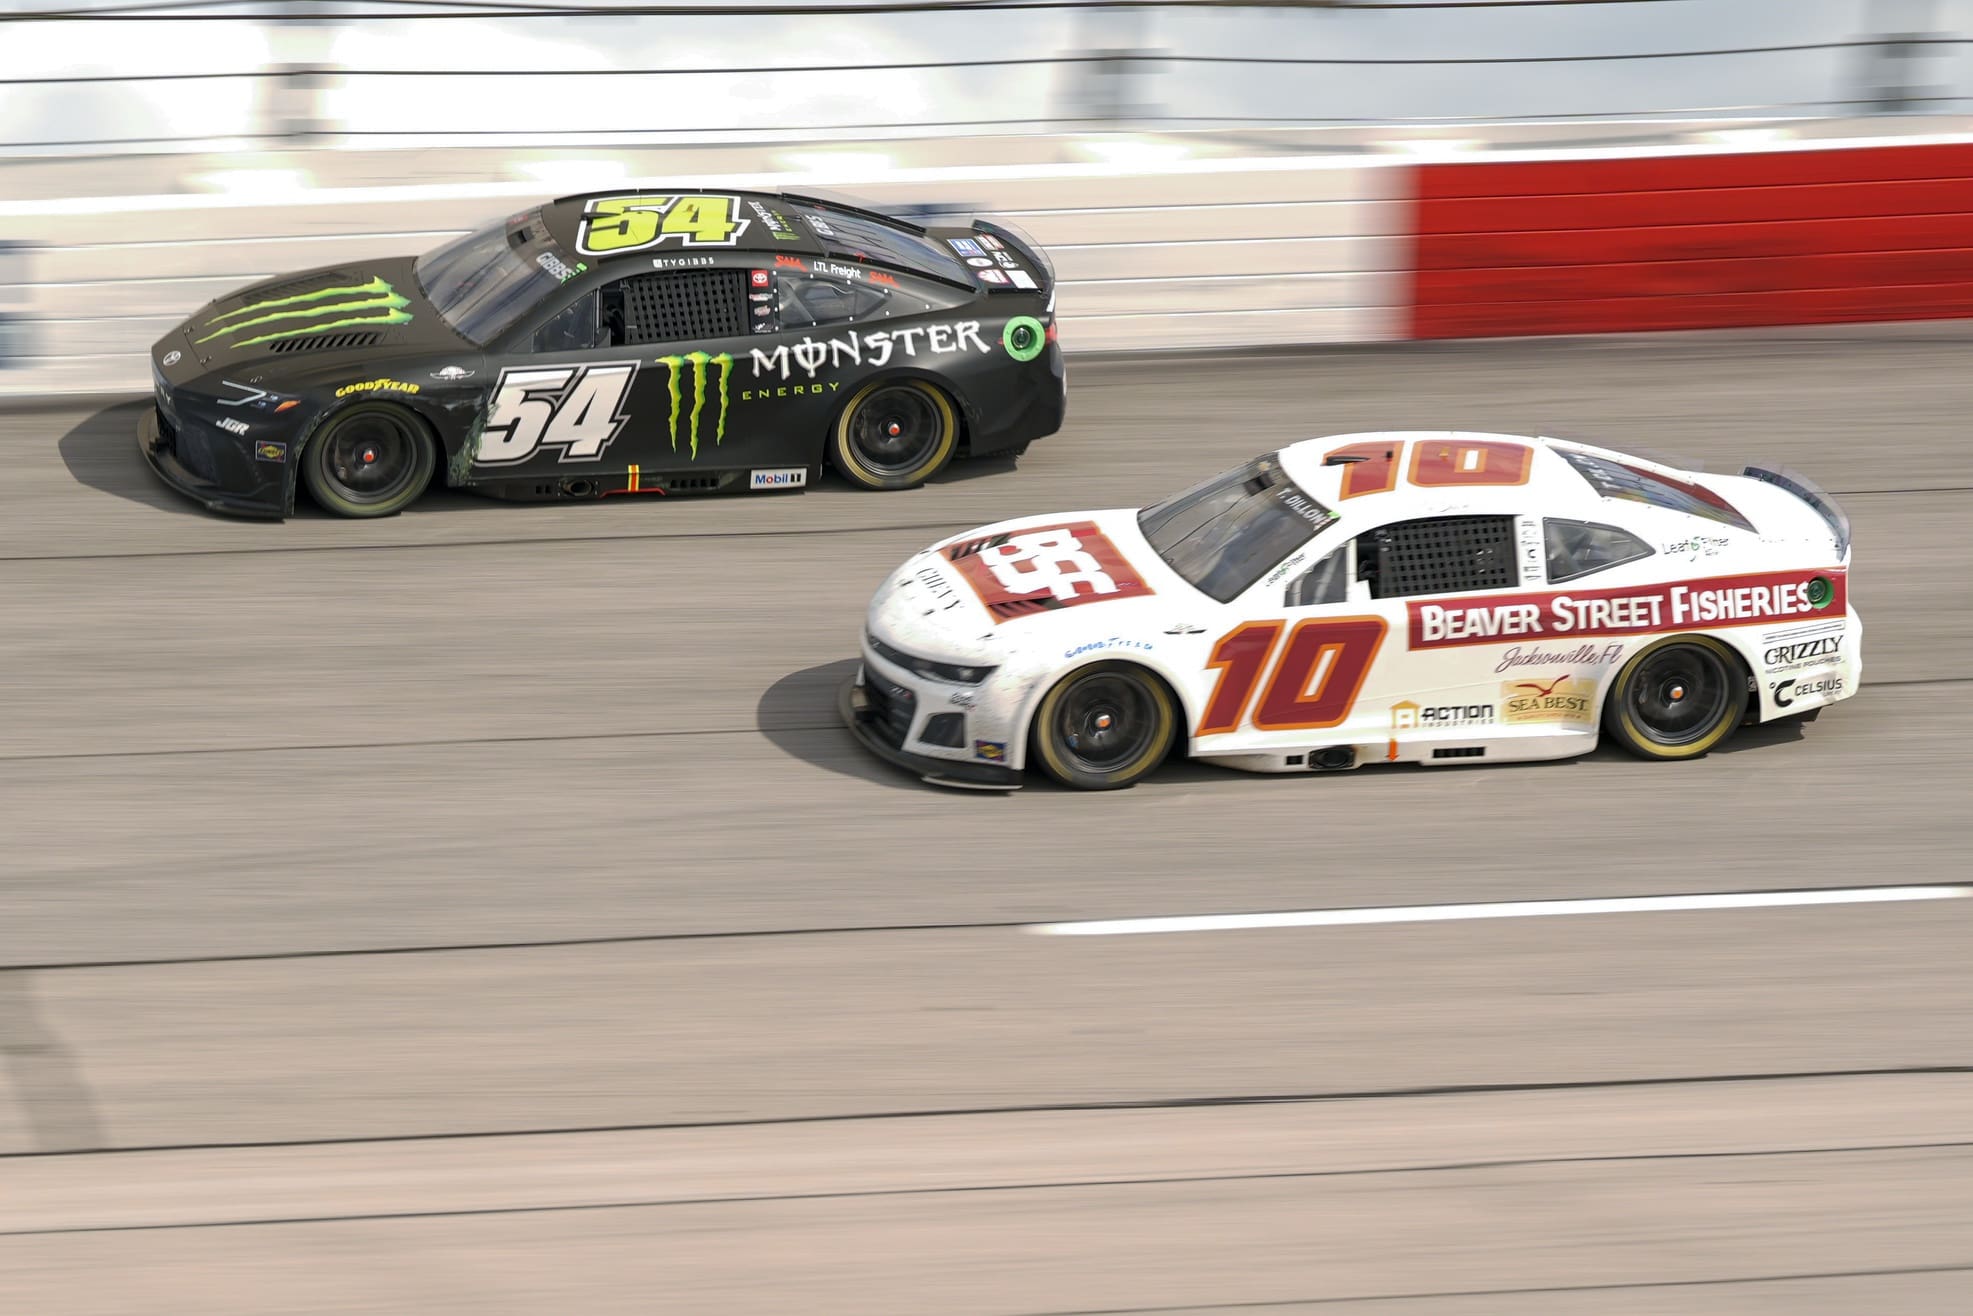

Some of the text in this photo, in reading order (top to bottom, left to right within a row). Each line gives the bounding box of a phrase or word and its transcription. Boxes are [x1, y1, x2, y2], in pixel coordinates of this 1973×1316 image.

[576, 194, 751, 256] 54
[536, 251, 573, 280] GIBBS
[813, 260, 862, 281] LTL Freight
[751, 321, 991, 379] MONSTER
[335, 378, 420, 398] GOODYEAR
[742, 381, 840, 401] ENERGY
[215, 416, 250, 436] JGR
[473, 360, 642, 468] 54
[754, 473, 789, 485] Mobil
[1321, 440, 1535, 502] 10
[1422, 582, 1813, 639] BEAVER STREET FISHERIES
[1764, 634, 1844, 665] GRIZZLY
[1195, 615, 1388, 737] 10
[1794, 678, 1842, 697] CELSIUS
[1421, 704, 1493, 721] ACTION
[1509, 696, 1589, 713] SEA BEST
